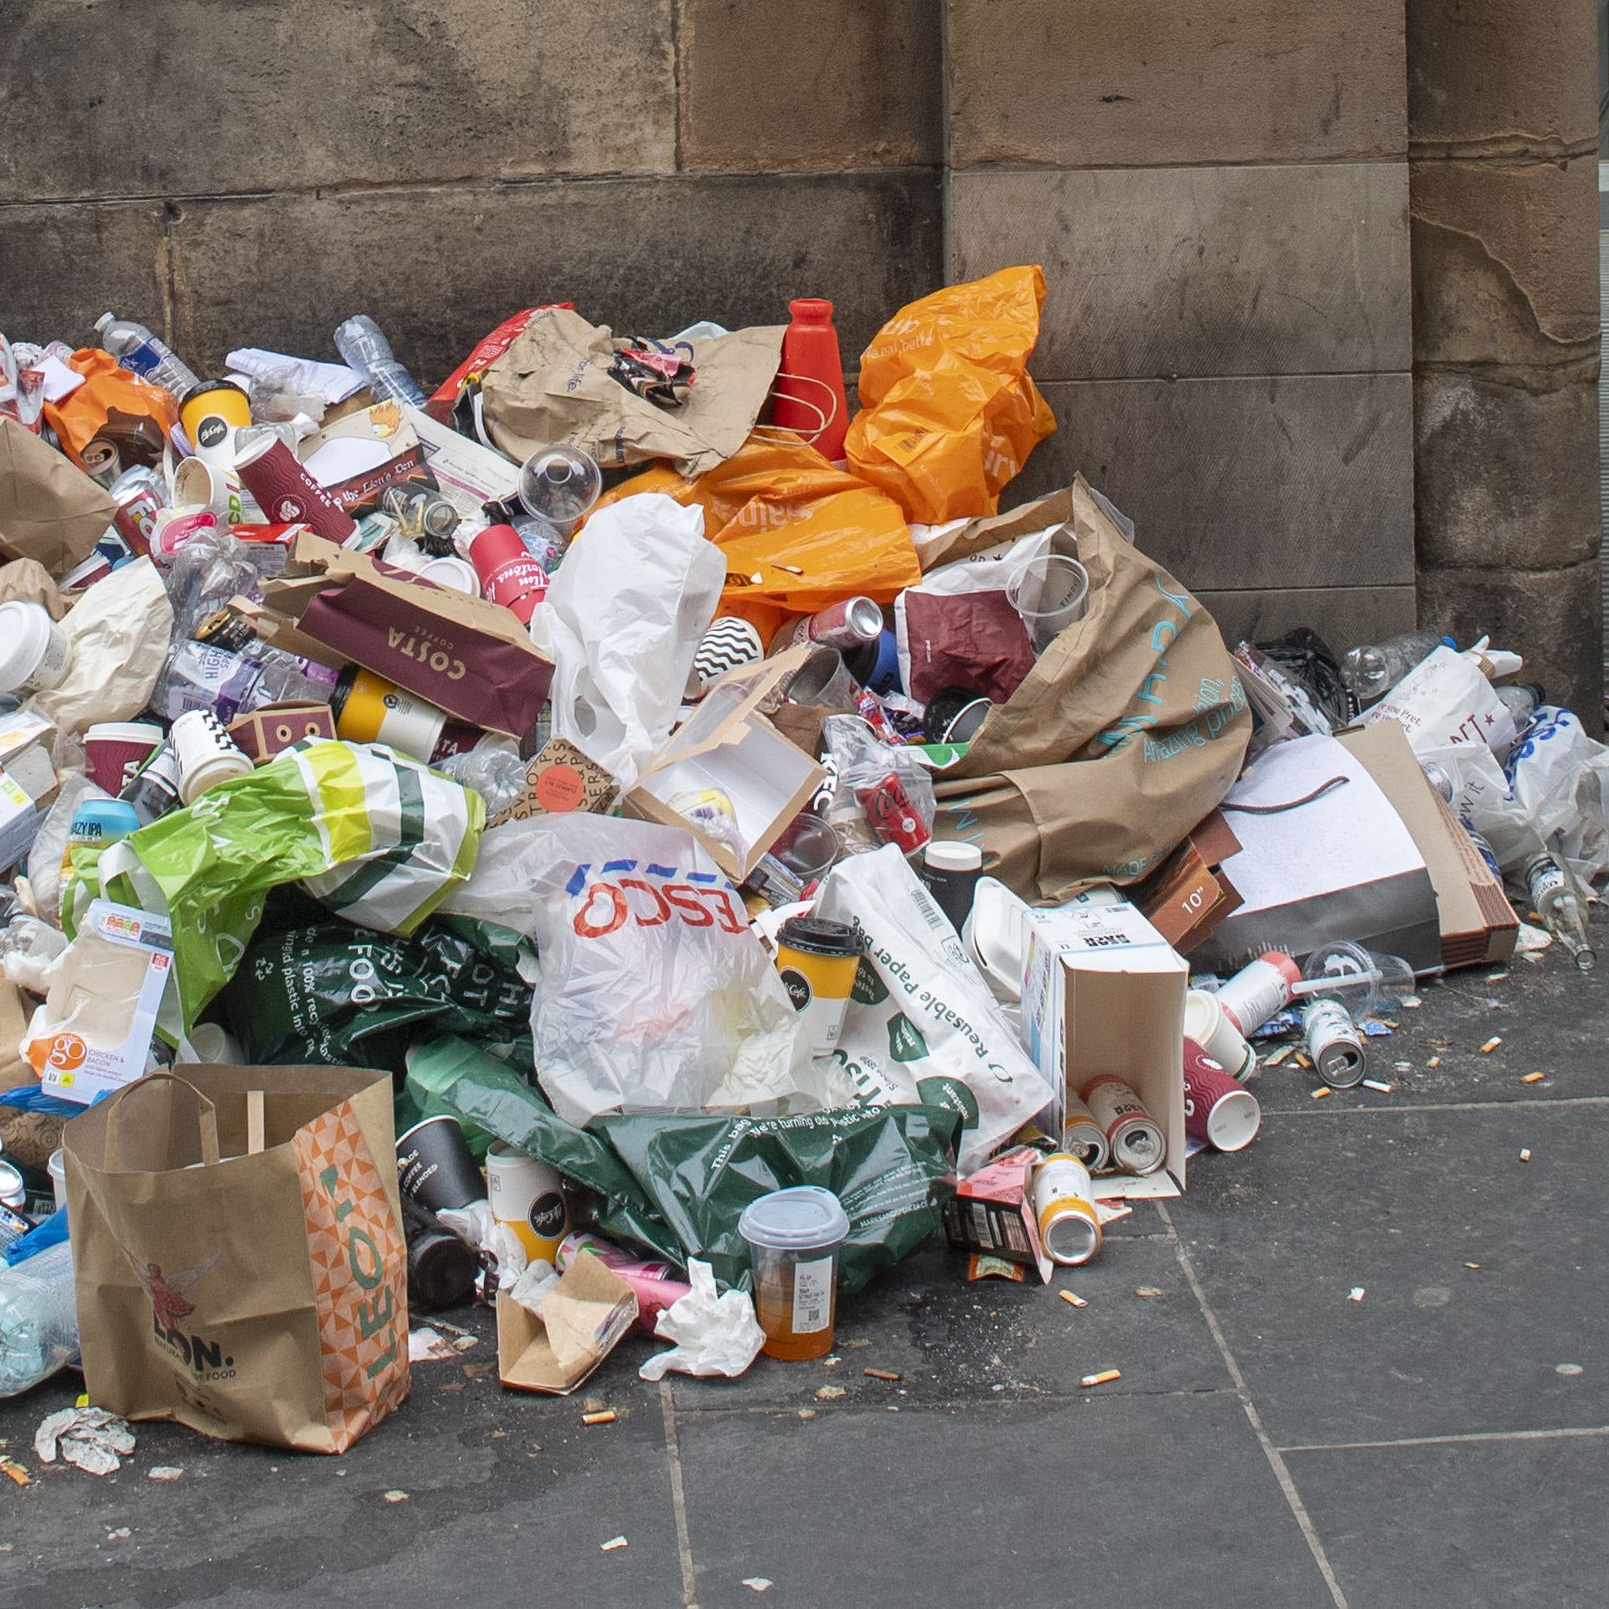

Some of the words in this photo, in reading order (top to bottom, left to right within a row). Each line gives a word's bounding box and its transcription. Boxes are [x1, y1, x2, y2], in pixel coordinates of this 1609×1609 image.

[387, 625, 467, 681] COSTA
[412, 624, 455, 651] COFFEE
[813, 751, 838, 812] KFC
[88, 822, 102, 837] IPA
[572, 877, 749, 938] ESCO
[281, 967, 300, 1012] plastic
[873, 947, 920, 995] Paper
[919, 989, 989, 1059] Reusable
[49, 1039, 87, 1066] go
[710, 1142, 732, 1171] This
[727, 1118, 752, 1140] bag
[779, 1116, 815, 1130] turning
[206, 1369, 237, 1381] FOOD
